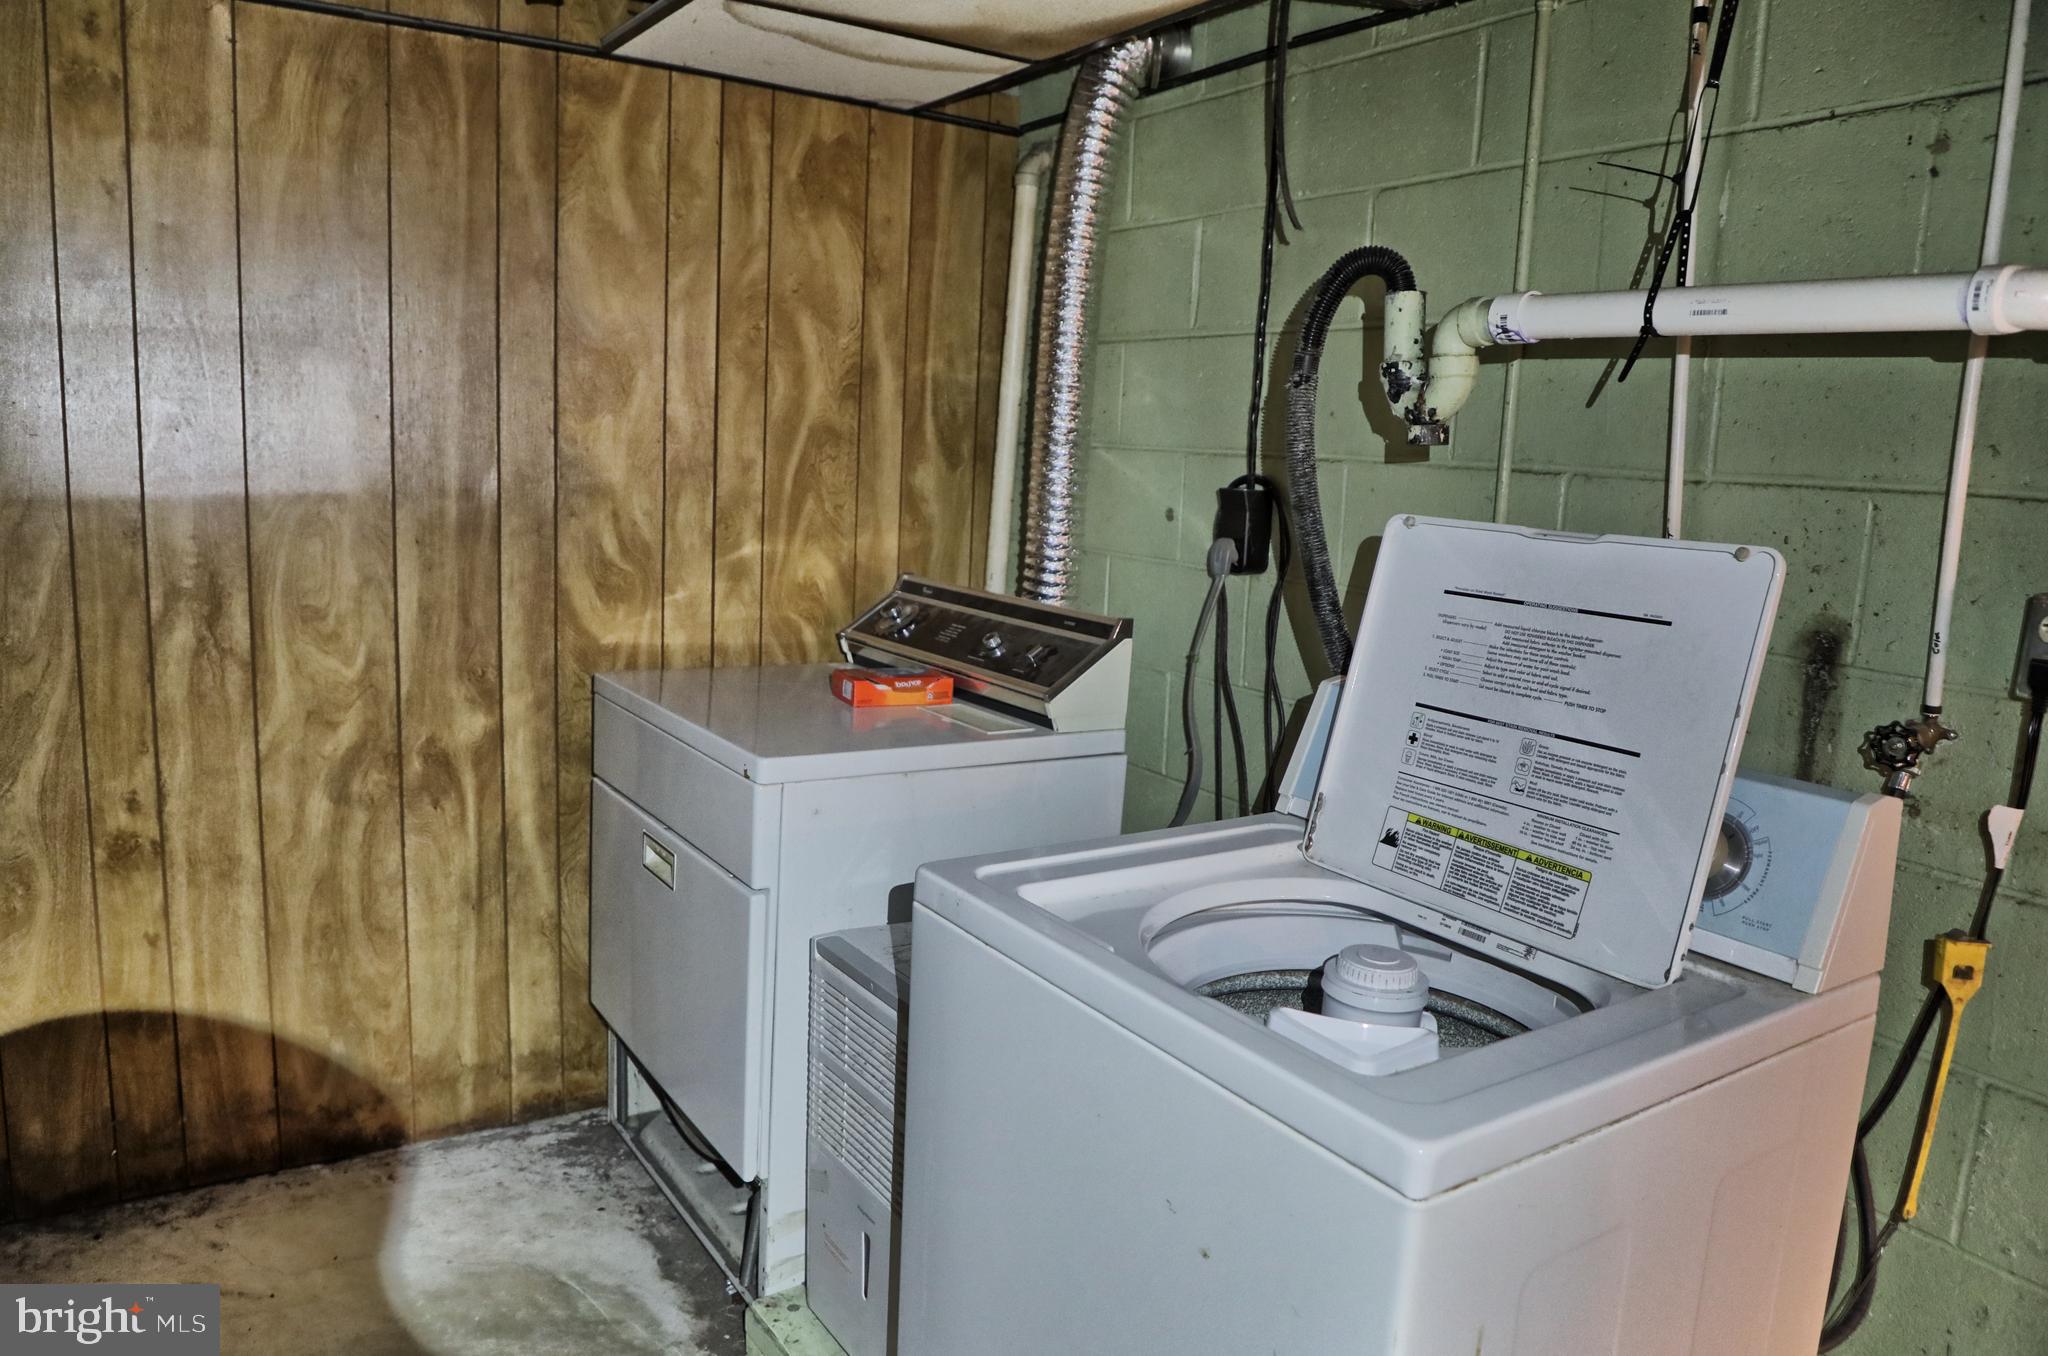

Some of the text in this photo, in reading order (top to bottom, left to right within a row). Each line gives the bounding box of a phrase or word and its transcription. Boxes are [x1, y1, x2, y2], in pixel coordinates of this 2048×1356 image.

[1563, 700, 1576, 708] PUSH
[1575, 703, 1588, 711] TIMER
[1421, 818, 1452, 834] WARNING
[1464, 833, 1519, 857] AVERTISSEMENT
[1533, 856, 1585, 879] ADVERTENCIA
